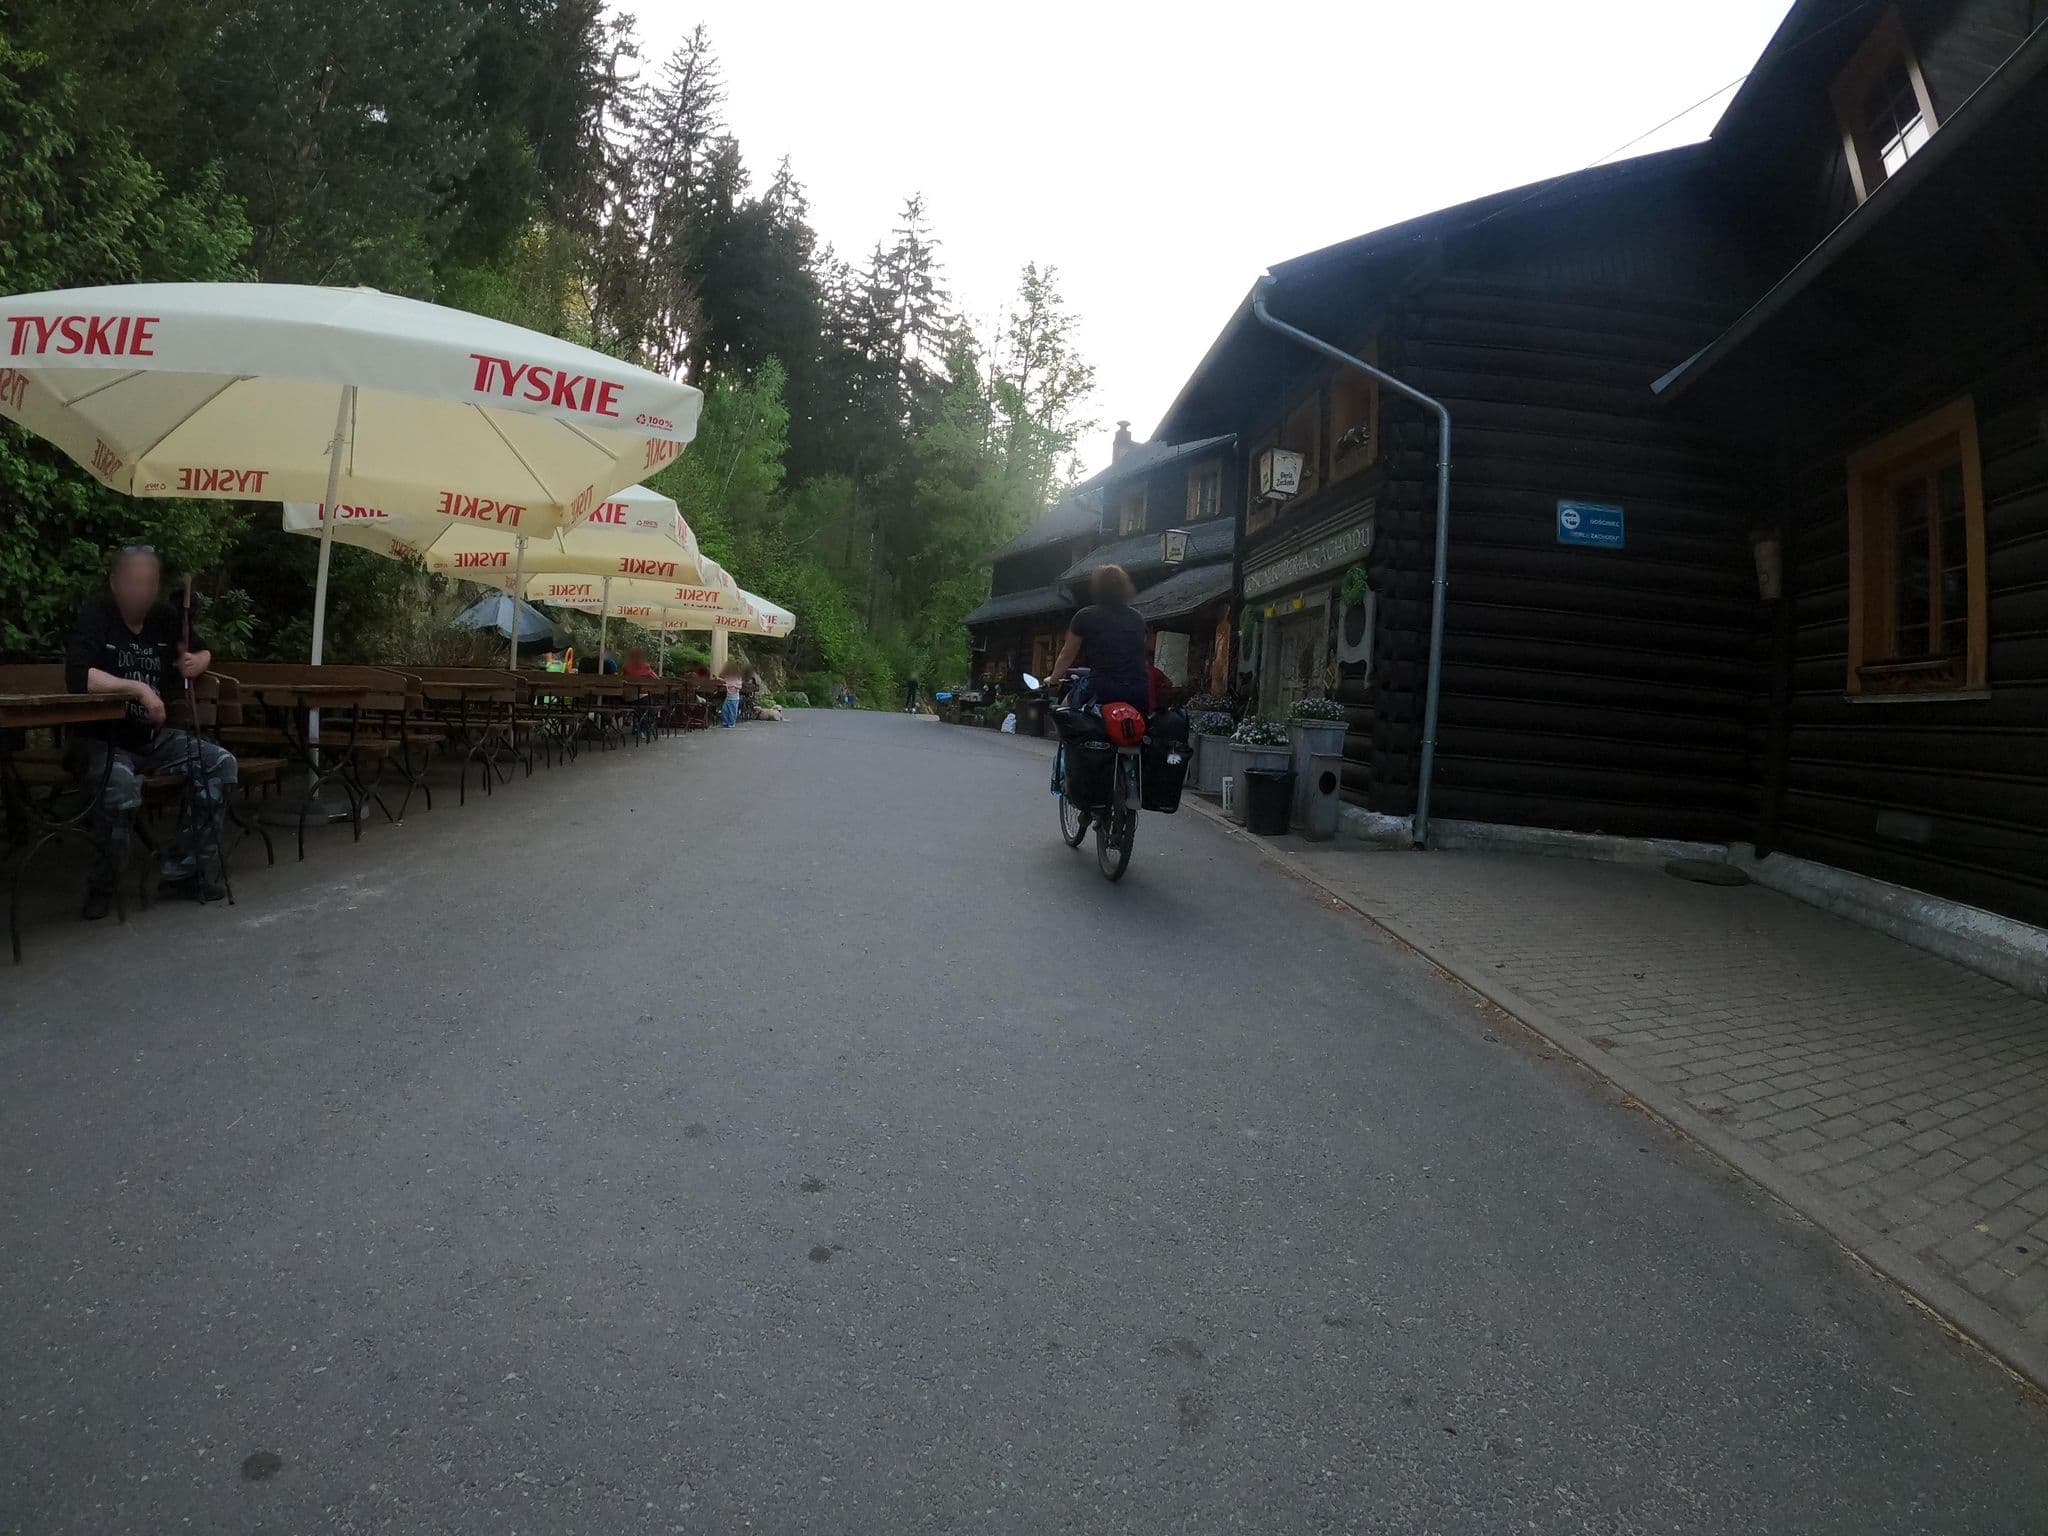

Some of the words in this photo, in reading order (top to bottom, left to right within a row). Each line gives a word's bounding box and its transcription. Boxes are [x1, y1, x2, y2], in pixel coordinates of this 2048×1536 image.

[7, 316, 160, 356] TYSKIE
[470, 353, 624, 418] TYSKIE
[648, 416, 673, 428] 100%
[588, 502, 629, 525] KIE
